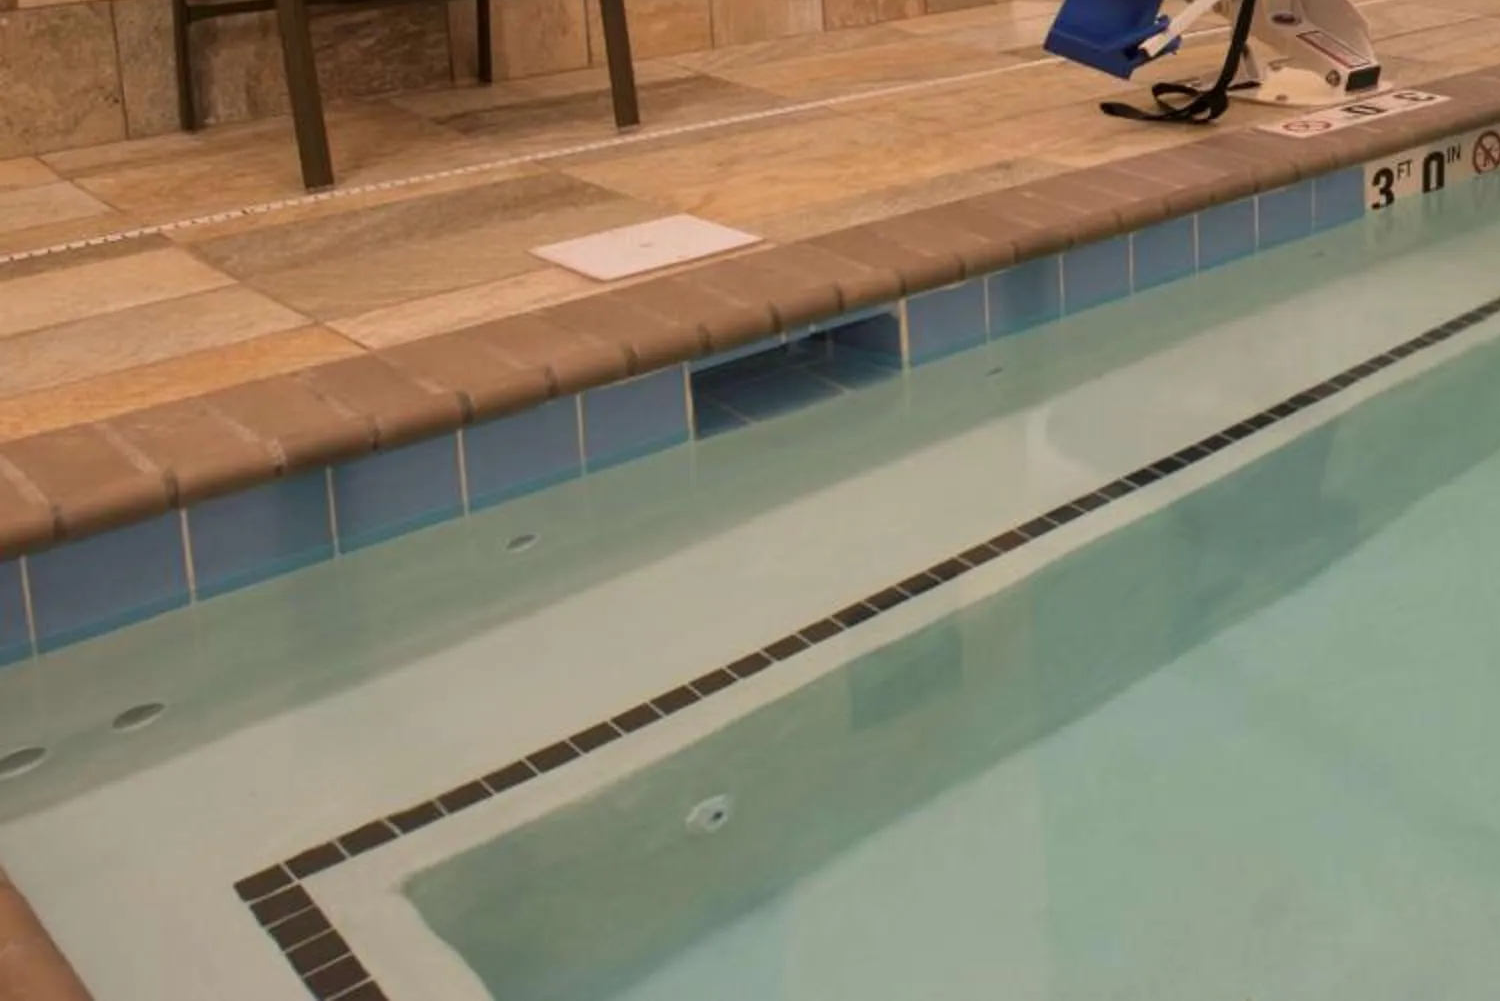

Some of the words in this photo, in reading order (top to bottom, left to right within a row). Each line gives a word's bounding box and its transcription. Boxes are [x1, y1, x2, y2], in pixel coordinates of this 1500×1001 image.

[1371, 167, 1395, 210] 3
[1397, 160, 1413, 181] FT
[1421, 151, 1445, 194] 0
[1446, 144, 1462, 164] IN
